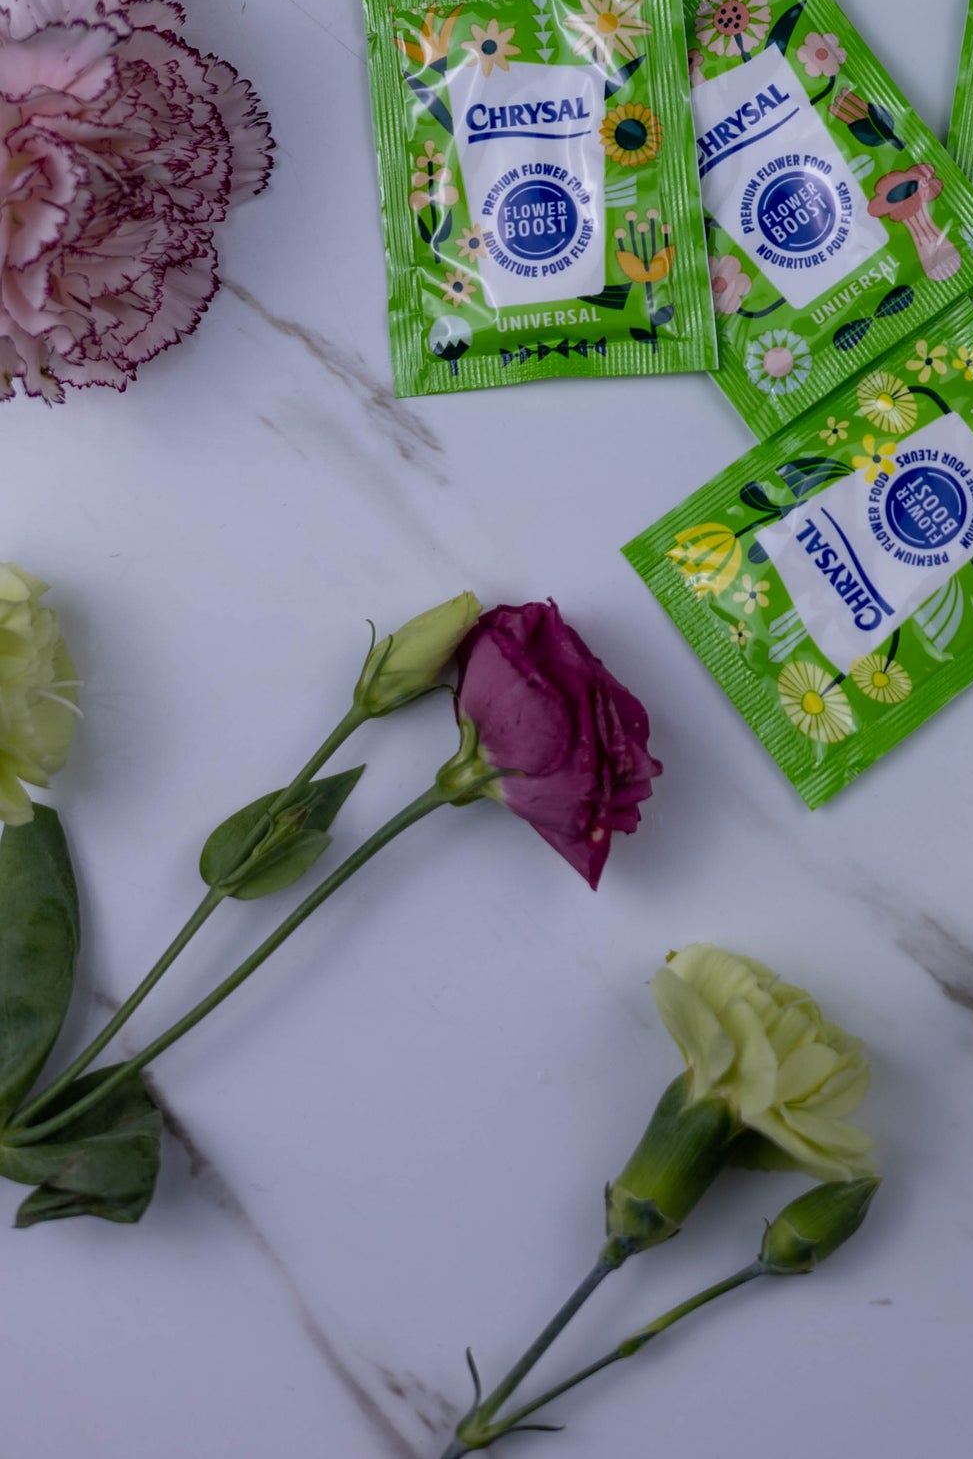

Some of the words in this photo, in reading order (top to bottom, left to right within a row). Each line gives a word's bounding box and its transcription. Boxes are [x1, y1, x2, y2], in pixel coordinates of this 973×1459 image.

[466, 98, 590, 131] CHRYSAL
[482, 169, 520, 216] PREMIUM
[522, 163, 568, 181] FLOWER
[567, 176, 590, 205] FOOD
[504, 201, 567, 220] FLOWER
[740, 180, 757, 234] PREMIUM
[757, 154, 800, 182] FLOWER
[804, 154, 832, 175] FOOD
[762, 181, 818, 228] FLOWER
[836, 181, 852, 224] FLEURS
[505, 216, 568, 239] BOOST
[770, 194, 827, 243] BOOST
[483, 231, 538, 278] NOURRITURE
[542, 257, 571, 276] POUR
[572, 218, 594, 259] FLEURS
[756, 244, 827, 269] NOURRITURE
[826, 227, 849, 256] POUR
[811, 255, 900, 325] UNIVERSAL
[497, 307, 601, 332] UNIVERSAL
[896, 449, 939, 468] FLEURS
[941, 451, 969, 477] POUR
[869, 472, 890, 502] FOOD
[907, 476, 959, 536] BOOST
[868, 508, 896, 552] FLOWER
[896, 485, 944, 545] FLOWER
[796, 518, 882, 631] CHRYSAL
[893, 546, 949, 567] PREMIUM
